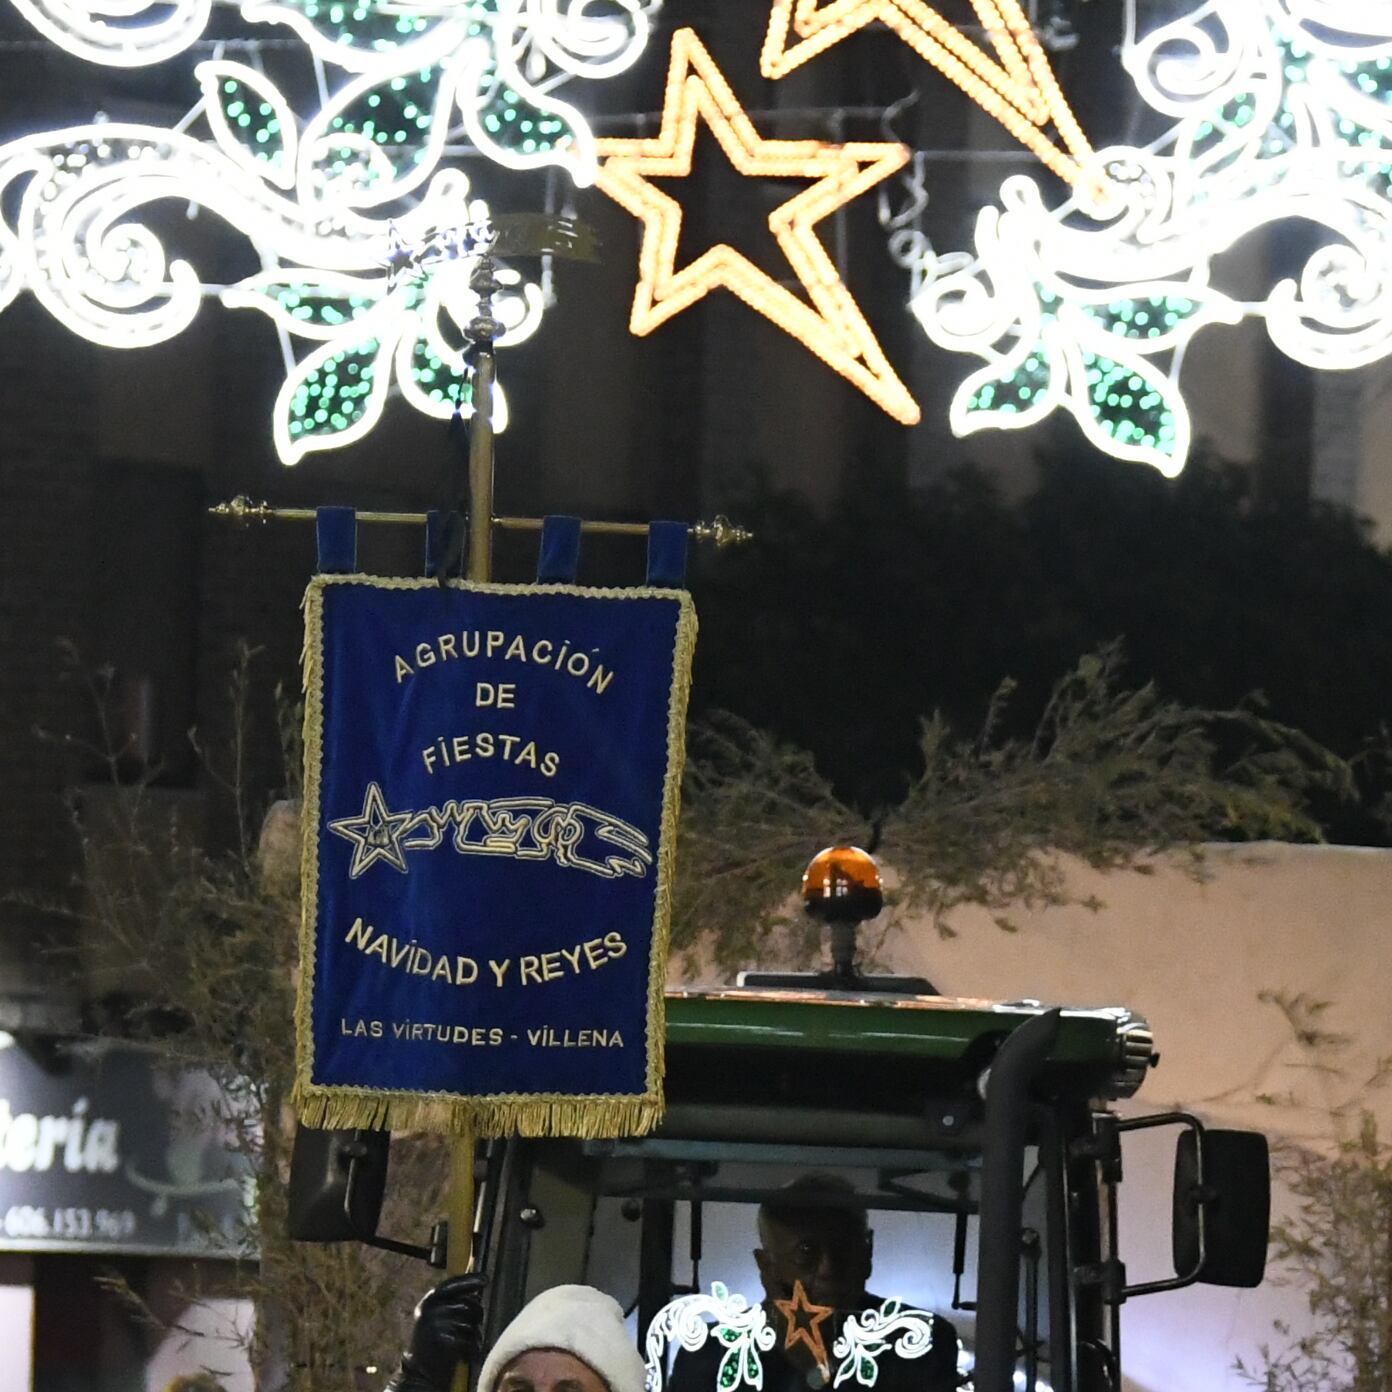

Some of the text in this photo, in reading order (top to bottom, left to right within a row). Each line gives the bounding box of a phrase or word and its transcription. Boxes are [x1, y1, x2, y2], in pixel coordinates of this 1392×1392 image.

[394, 630, 614, 695] AGRUPACIÓN
[475, 682, 516, 709] DE
[421, 732, 560, 778] FIESTAS
[344, 917, 628, 988] NAVIDAD Y REYES
[340, 1017, 384, 1038] LAS
[391, 1017, 504, 1046] VIRTUDES
[526, 1024, 624, 1048] VILLENA
